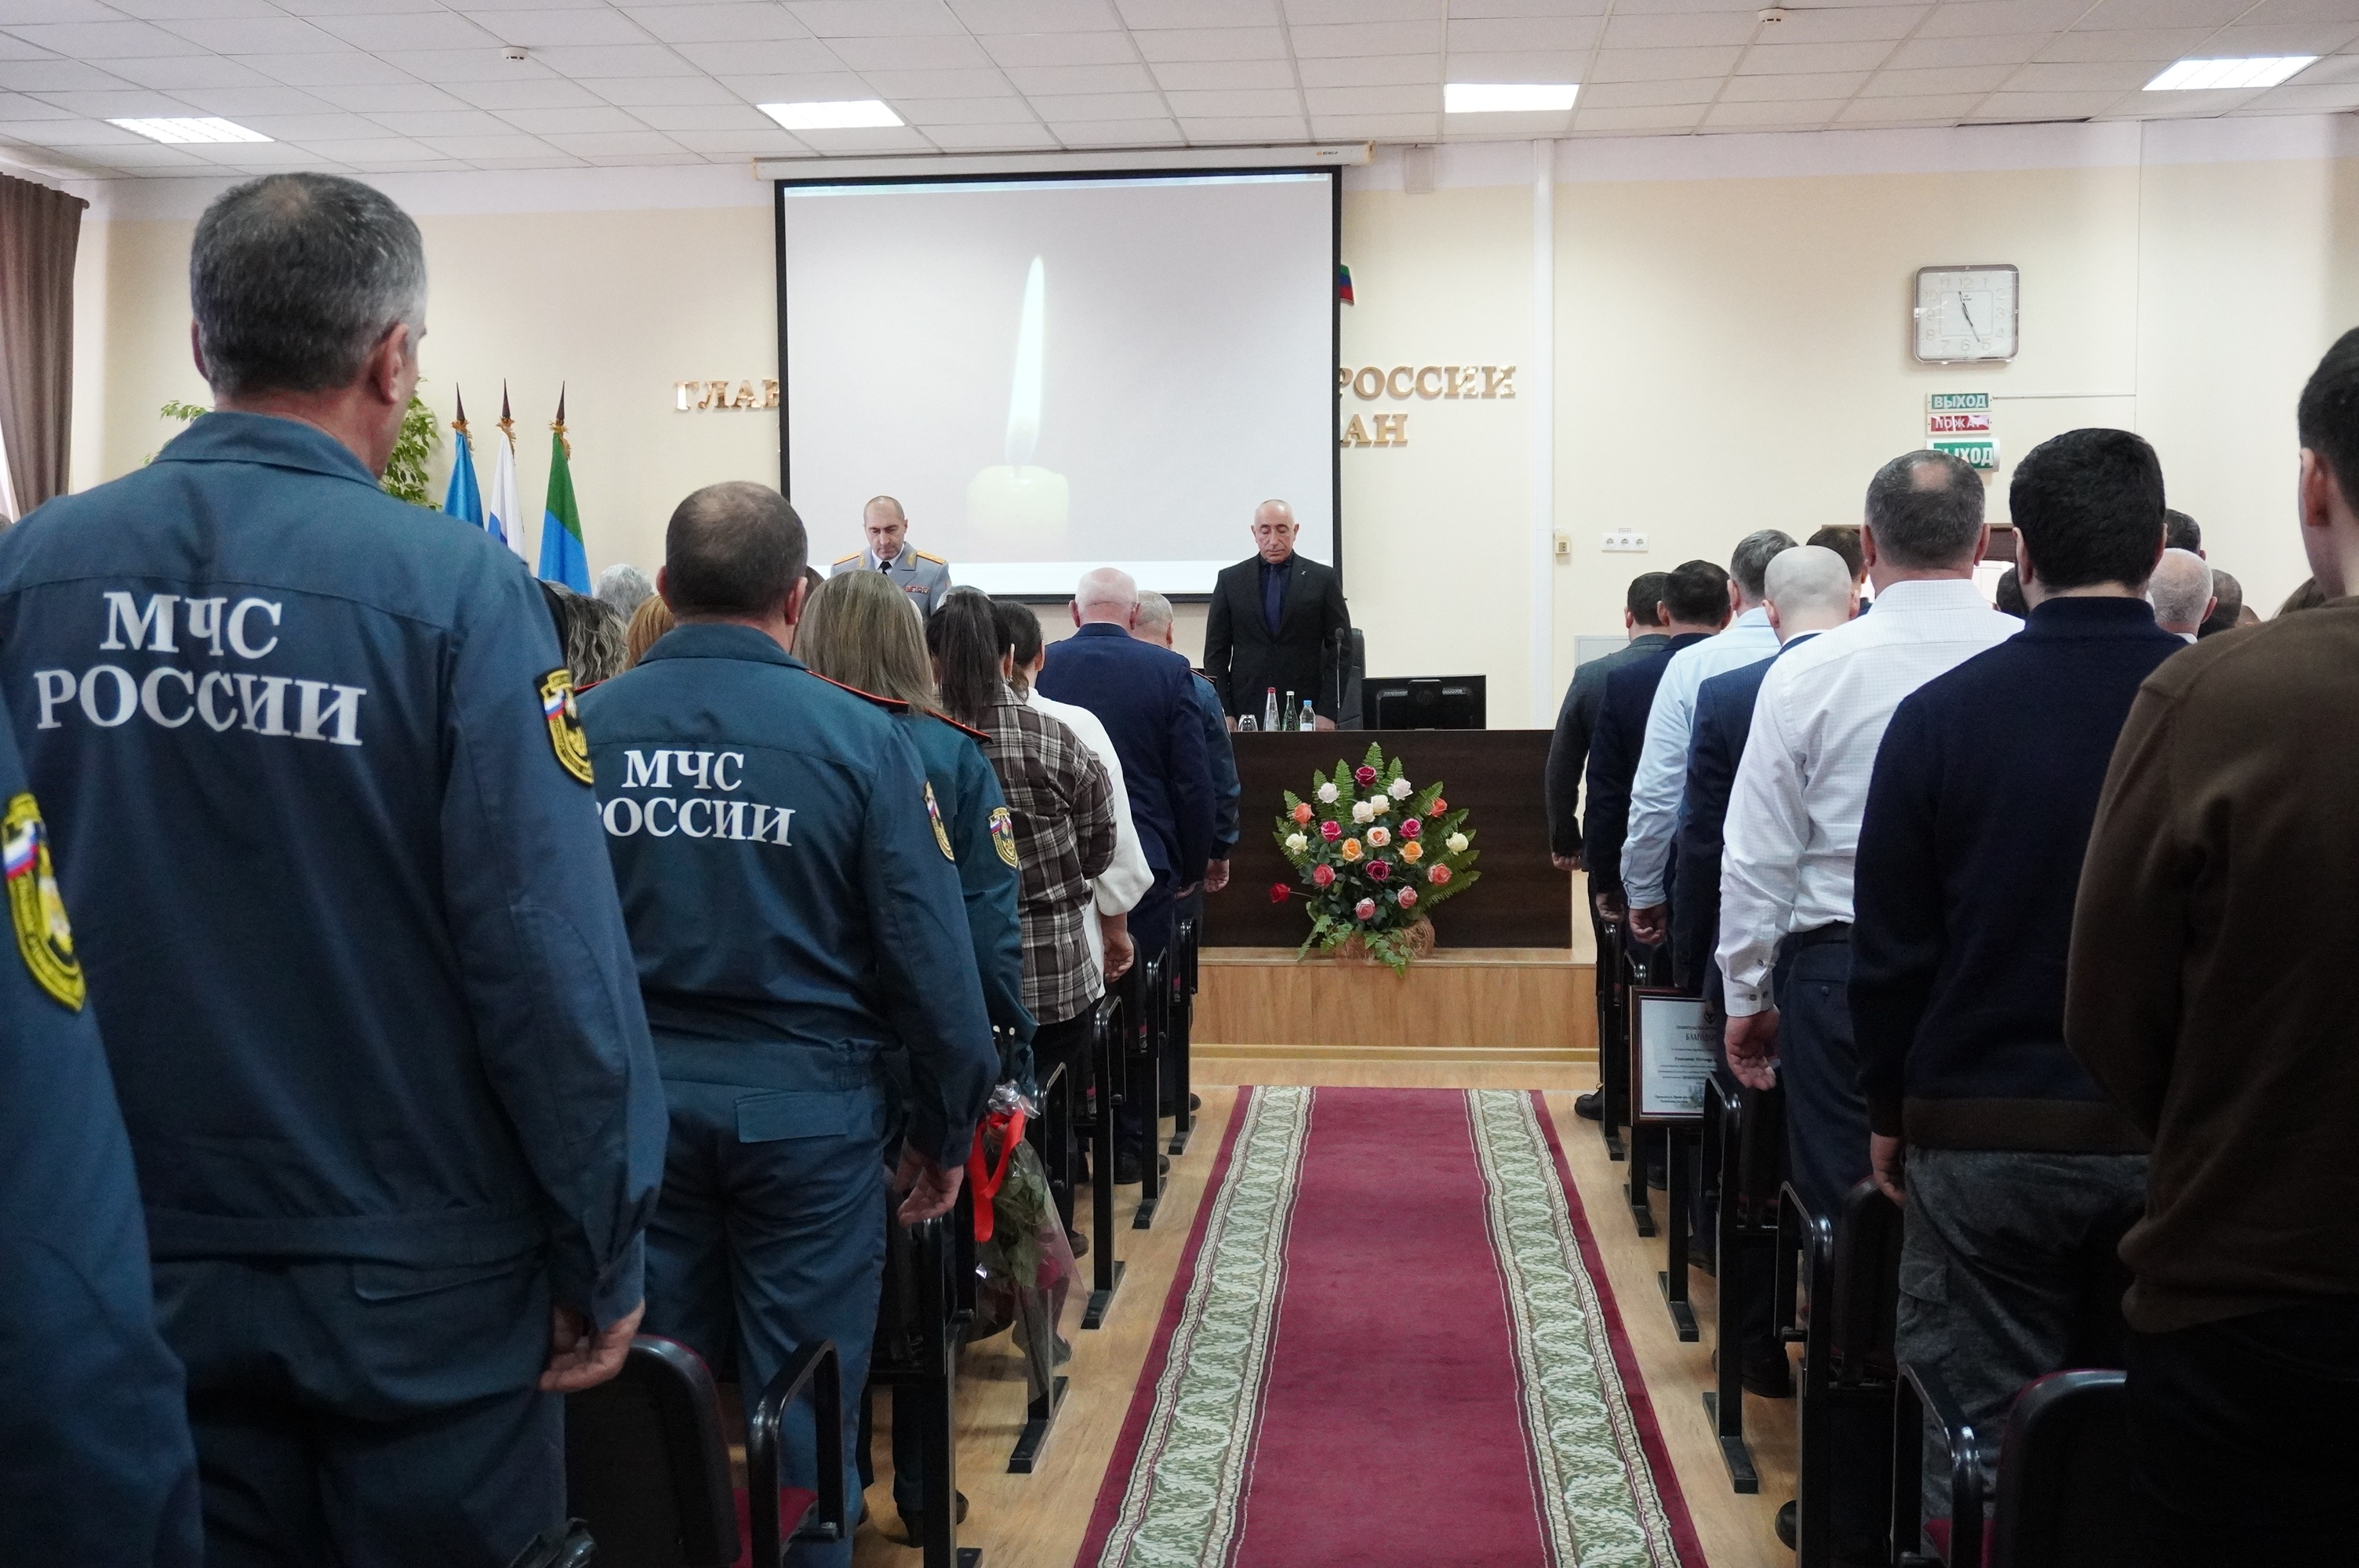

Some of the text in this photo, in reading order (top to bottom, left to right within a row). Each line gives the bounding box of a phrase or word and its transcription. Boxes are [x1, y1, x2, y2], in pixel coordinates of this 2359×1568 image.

[1934, 395, 1986, 408] ВЫХОД
[1935, 418, 1981, 429] ПОЖА
[1934, 447, 1993, 466] ХОД
[100, 591, 282, 659] МЧС
[33, 664, 368, 746] РОССИИ
[621, 750, 744, 791] МЧС
[596, 797, 796, 847] ОССИИ
